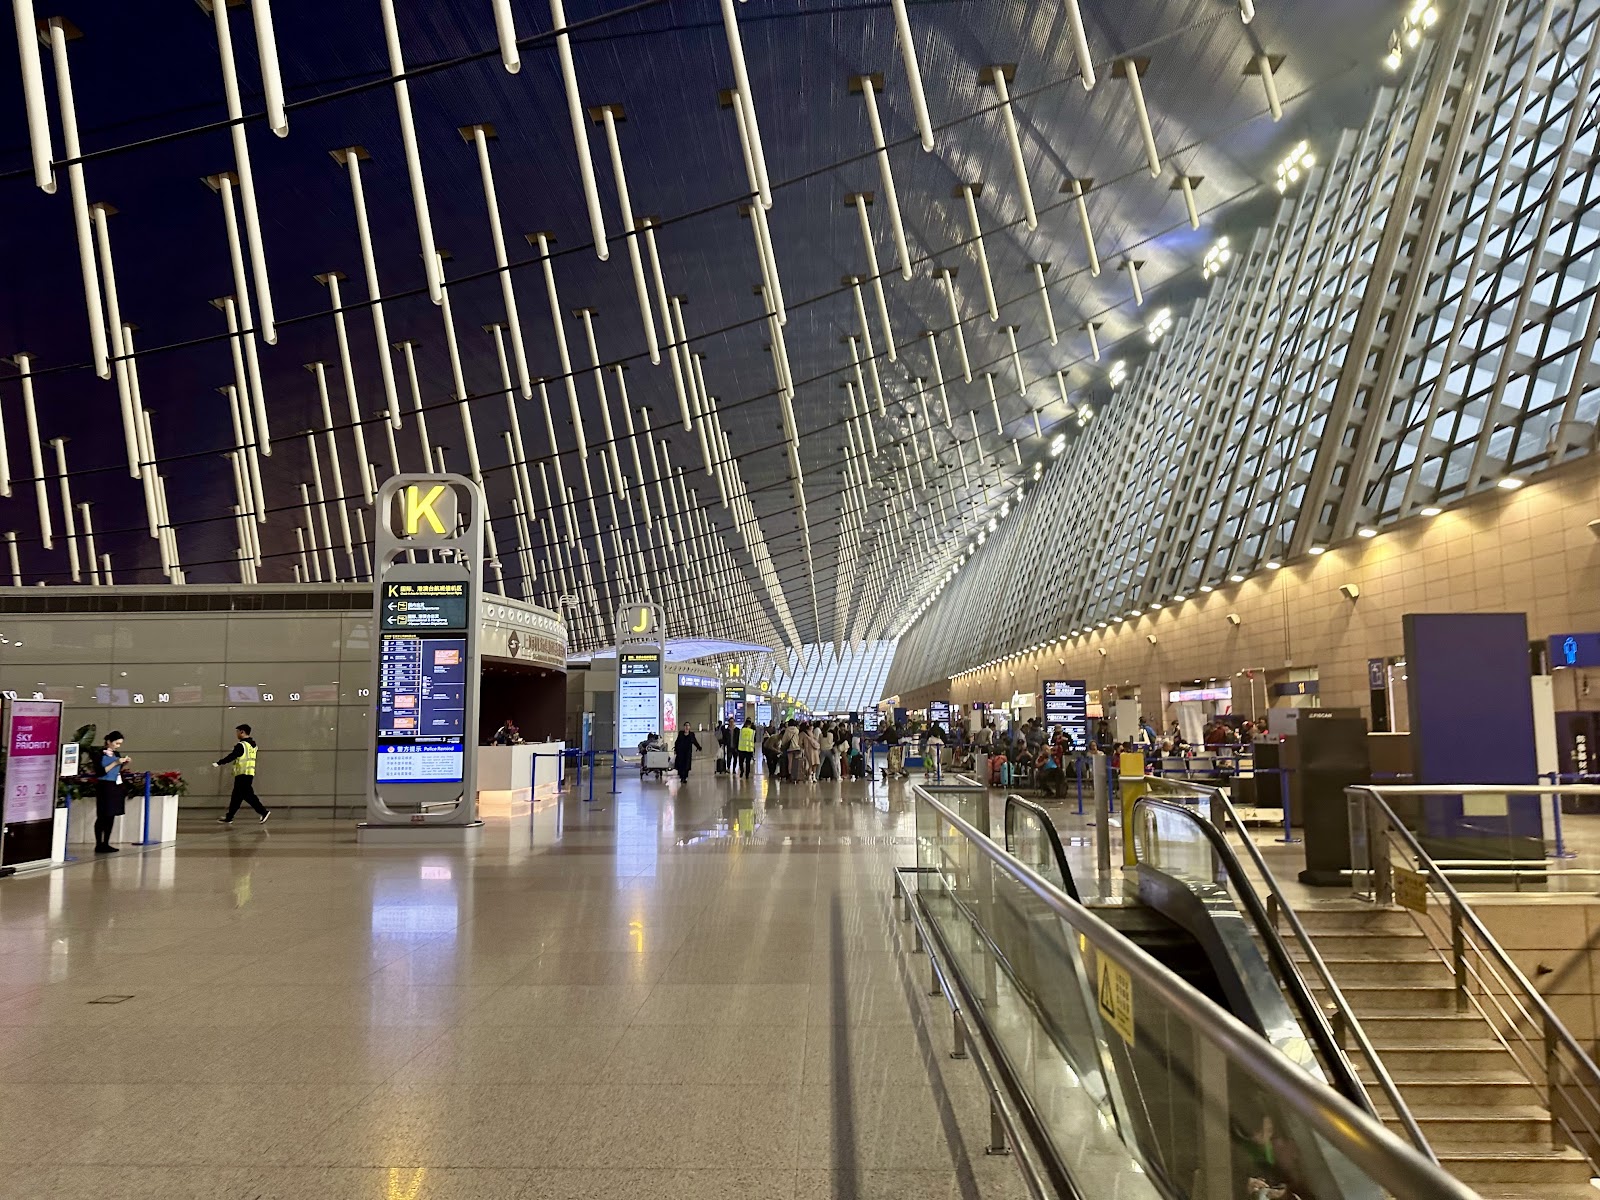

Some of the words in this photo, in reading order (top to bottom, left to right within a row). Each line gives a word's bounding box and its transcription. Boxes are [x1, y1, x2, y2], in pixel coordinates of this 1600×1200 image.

[407, 485, 446, 534] K
[388, 584, 399, 598] K
[632, 608, 648, 632] J
[729, 662, 740, 677] H
[1298, 682, 1305, 694] 11
[15, 733, 33, 742] SKY
[15, 741, 51, 749] PRIORITY
